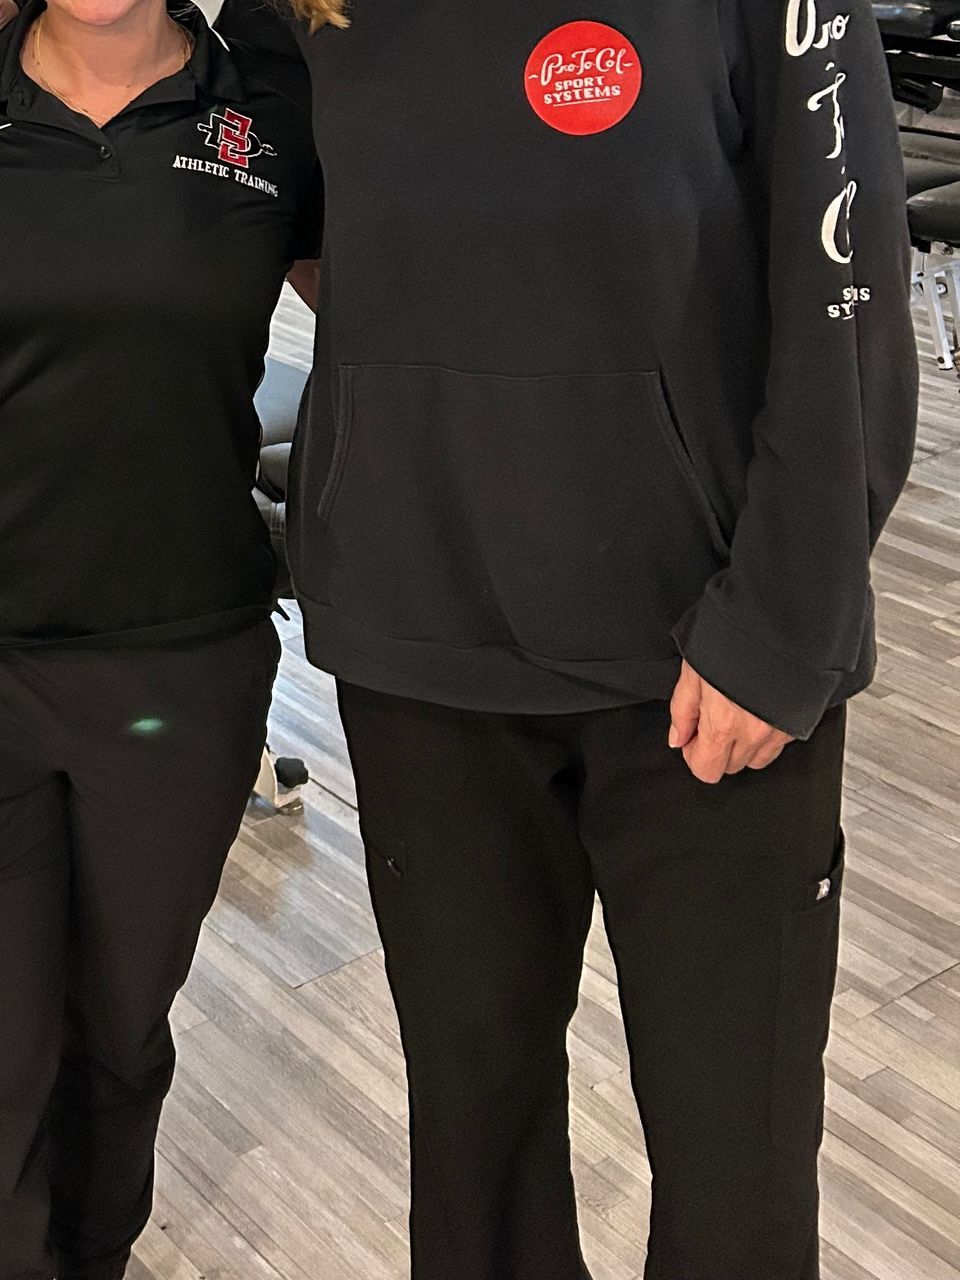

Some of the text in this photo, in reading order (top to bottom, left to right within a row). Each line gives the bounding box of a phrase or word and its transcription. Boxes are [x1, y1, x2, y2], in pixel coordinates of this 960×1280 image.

[554, 75, 605, 91] SPORT
[543, 85, 621, 105] SYSTEMS
[172, 154, 231, 179] ATHLETIC
